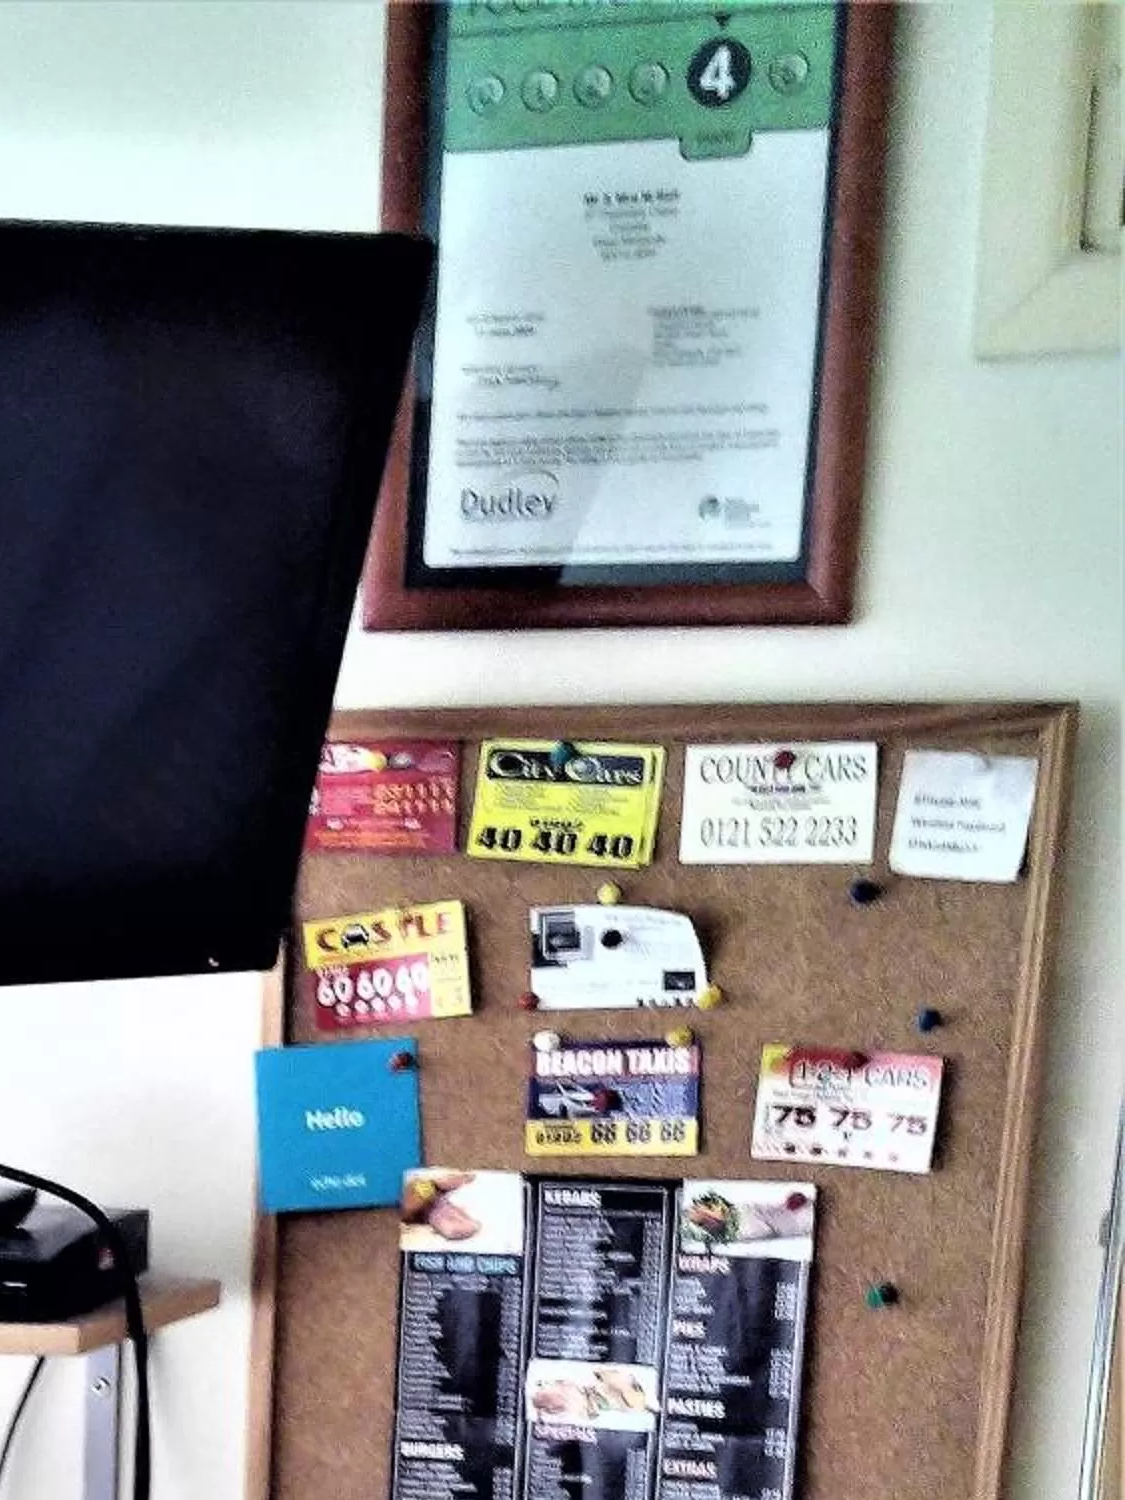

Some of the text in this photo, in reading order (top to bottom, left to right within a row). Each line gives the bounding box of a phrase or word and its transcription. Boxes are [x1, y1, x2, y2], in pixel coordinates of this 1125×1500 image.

[699, 45, 735, 99] 4
[460, 487, 556, 517] Dudley
[805, 754, 867, 783] CARS
[479, 826, 634, 858] 40 40 40
[700, 814, 858, 848] 0121 522 2233
[317, 961, 429, 1007] 60 60 60
[536, 1047, 693, 1077] BEACON TAXIS
[305, 1106, 365, 1131] Hello
[400, 1441, 465, 1460] BURGERS
